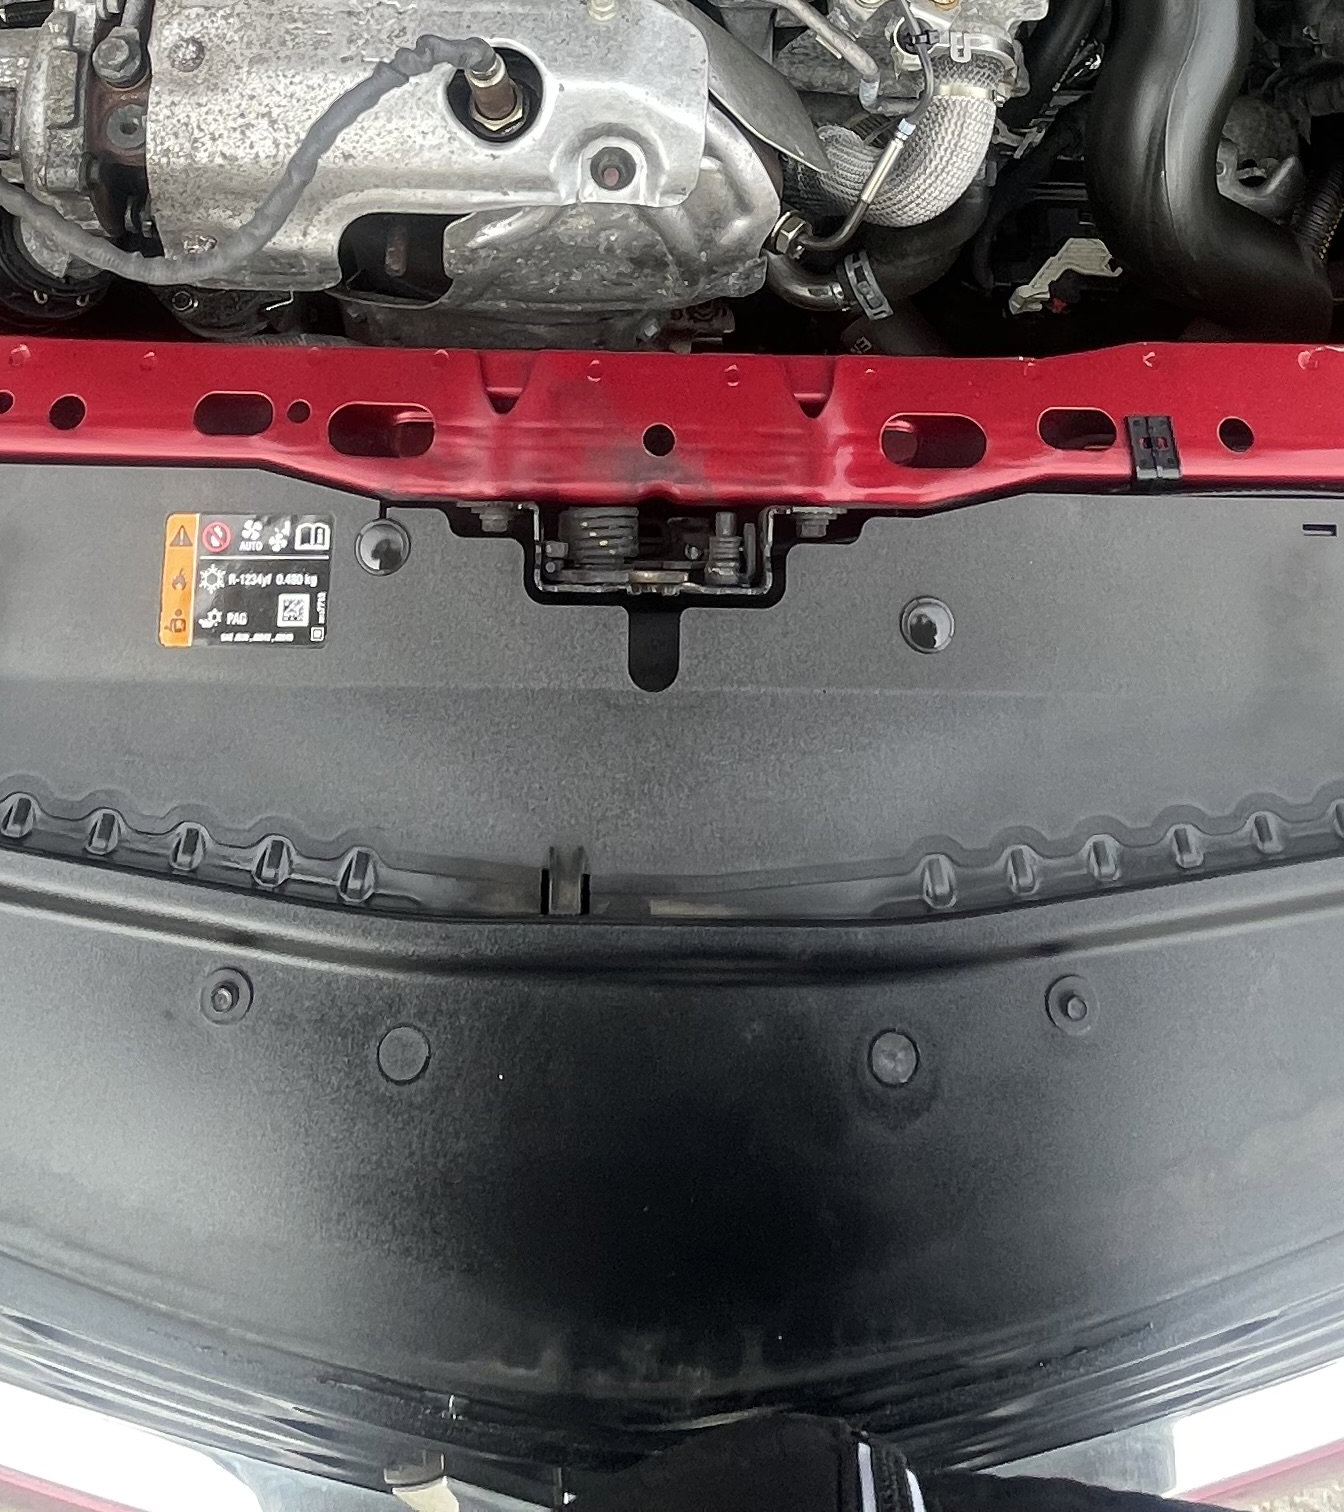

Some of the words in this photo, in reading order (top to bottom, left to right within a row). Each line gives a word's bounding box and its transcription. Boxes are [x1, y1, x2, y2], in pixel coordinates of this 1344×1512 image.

[239, 540, 263, 552] AUTO
[304, 573, 318, 588] kg
[226, 612, 248, 626] PAG
